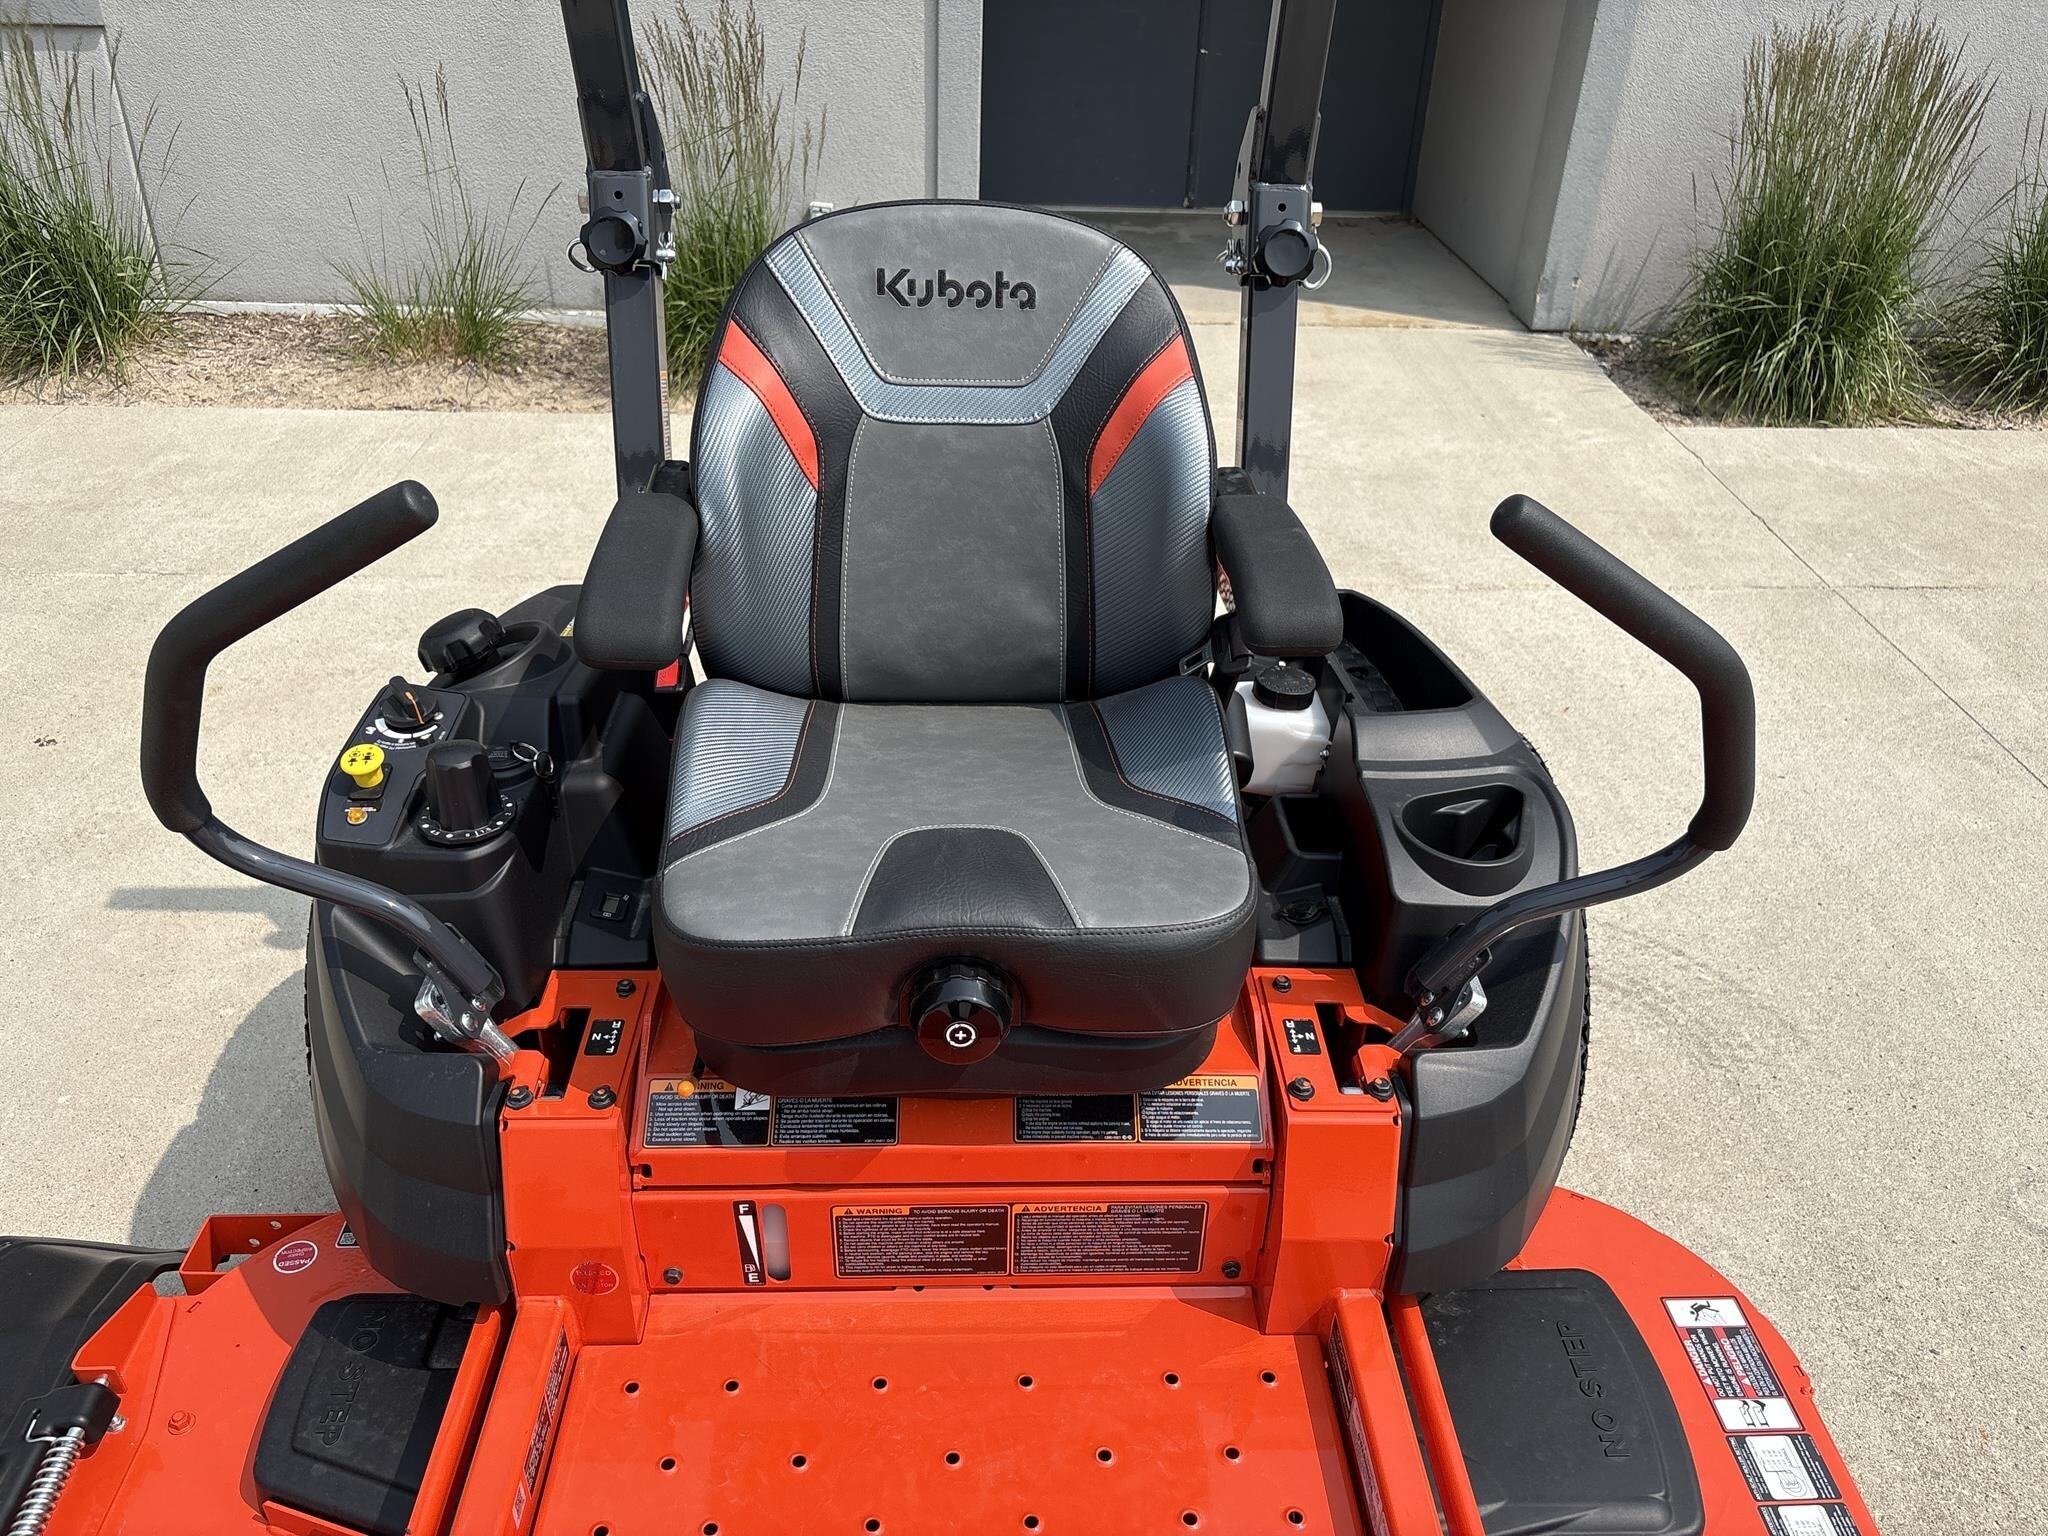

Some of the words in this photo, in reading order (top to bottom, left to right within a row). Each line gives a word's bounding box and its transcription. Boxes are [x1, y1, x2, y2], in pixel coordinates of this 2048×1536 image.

[876, 268, 1037, 310] Kubota
[1285, 1020, 1295, 1028] R
[1305, 1032, 1315, 1040] N
[1293, 1044, 1301, 1052] F
[697, 1082, 724, 1091] NING
[739, 1204, 749, 1214] F
[279, 1258, 310, 1267] PASSED
[748, 1273, 759, 1282] E
[351, 1310, 388, 1352] NO
[1697, 1329, 1711, 1345] WHEN
[1556, 1320, 1606, 1398] STEP
[1683, 1340, 1707, 1377] DANGER
[1695, 1344, 1711, 1362] HANDS
[1706, 1346, 1722, 1367] MOWER
[1712, 1342, 1728, 1367] RUNNING.
[1721, 1338, 1746, 1376] PELIGRO
[1705, 1363, 1717, 1374] PUT
[1717, 1368, 1729, 1381] INTO
[1711, 1375, 1721, 1387] NOT
[1729, 1375, 1744, 1396] ENGINE
[1715, 1388, 1726, 1396] DO
[1724, 1383, 1734, 1396] FEET
[315, 1361, 366, 1447] STEP
[1591, 1407, 1632, 1458] NO
